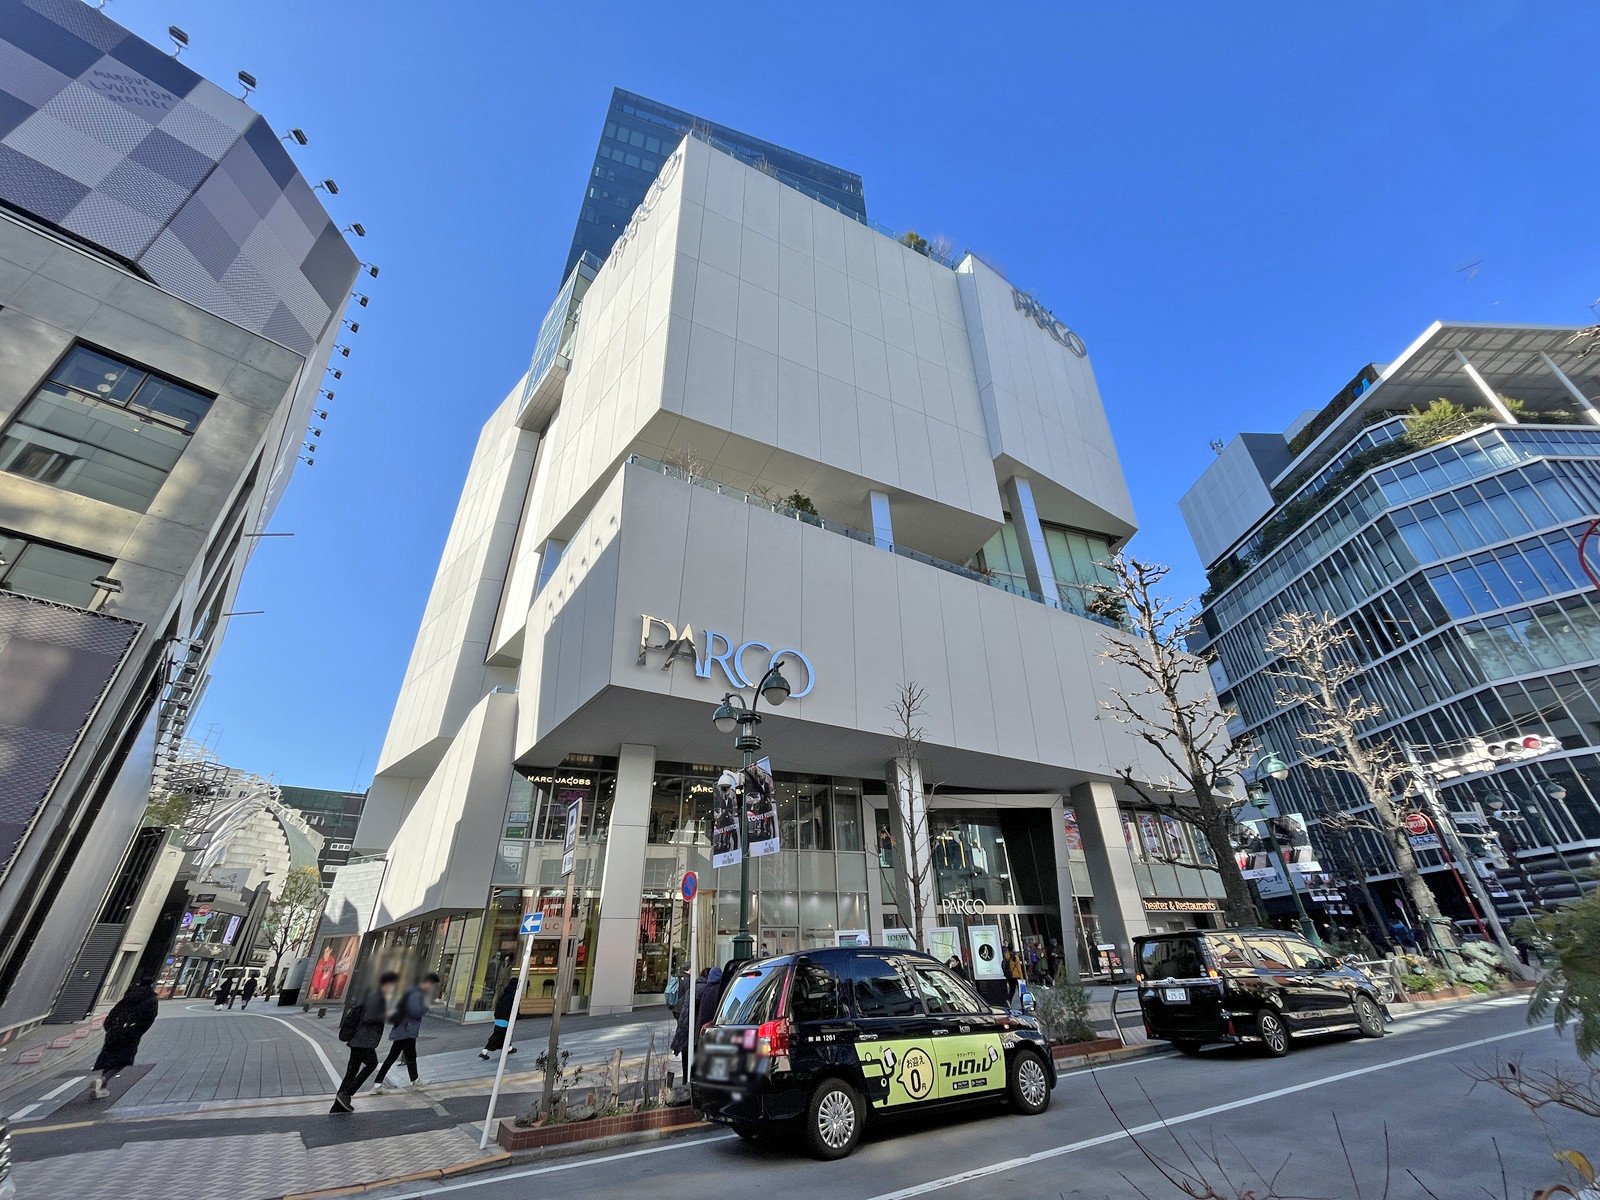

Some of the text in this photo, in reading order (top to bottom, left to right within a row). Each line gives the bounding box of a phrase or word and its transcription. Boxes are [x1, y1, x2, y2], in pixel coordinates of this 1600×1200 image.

[1012, 288, 1087, 358] PARCO
[636, 614, 815, 698] PARCO
[527, 775, 591, 786] MARC JACOBS
[690, 784, 714, 793] MARC
[941, 899, 986, 915] PARCO
[1176, 901, 1216, 910] Restaurants
[887, 934, 909, 942] LOEWE
[906, 1056, 925, 1068] お迎え
